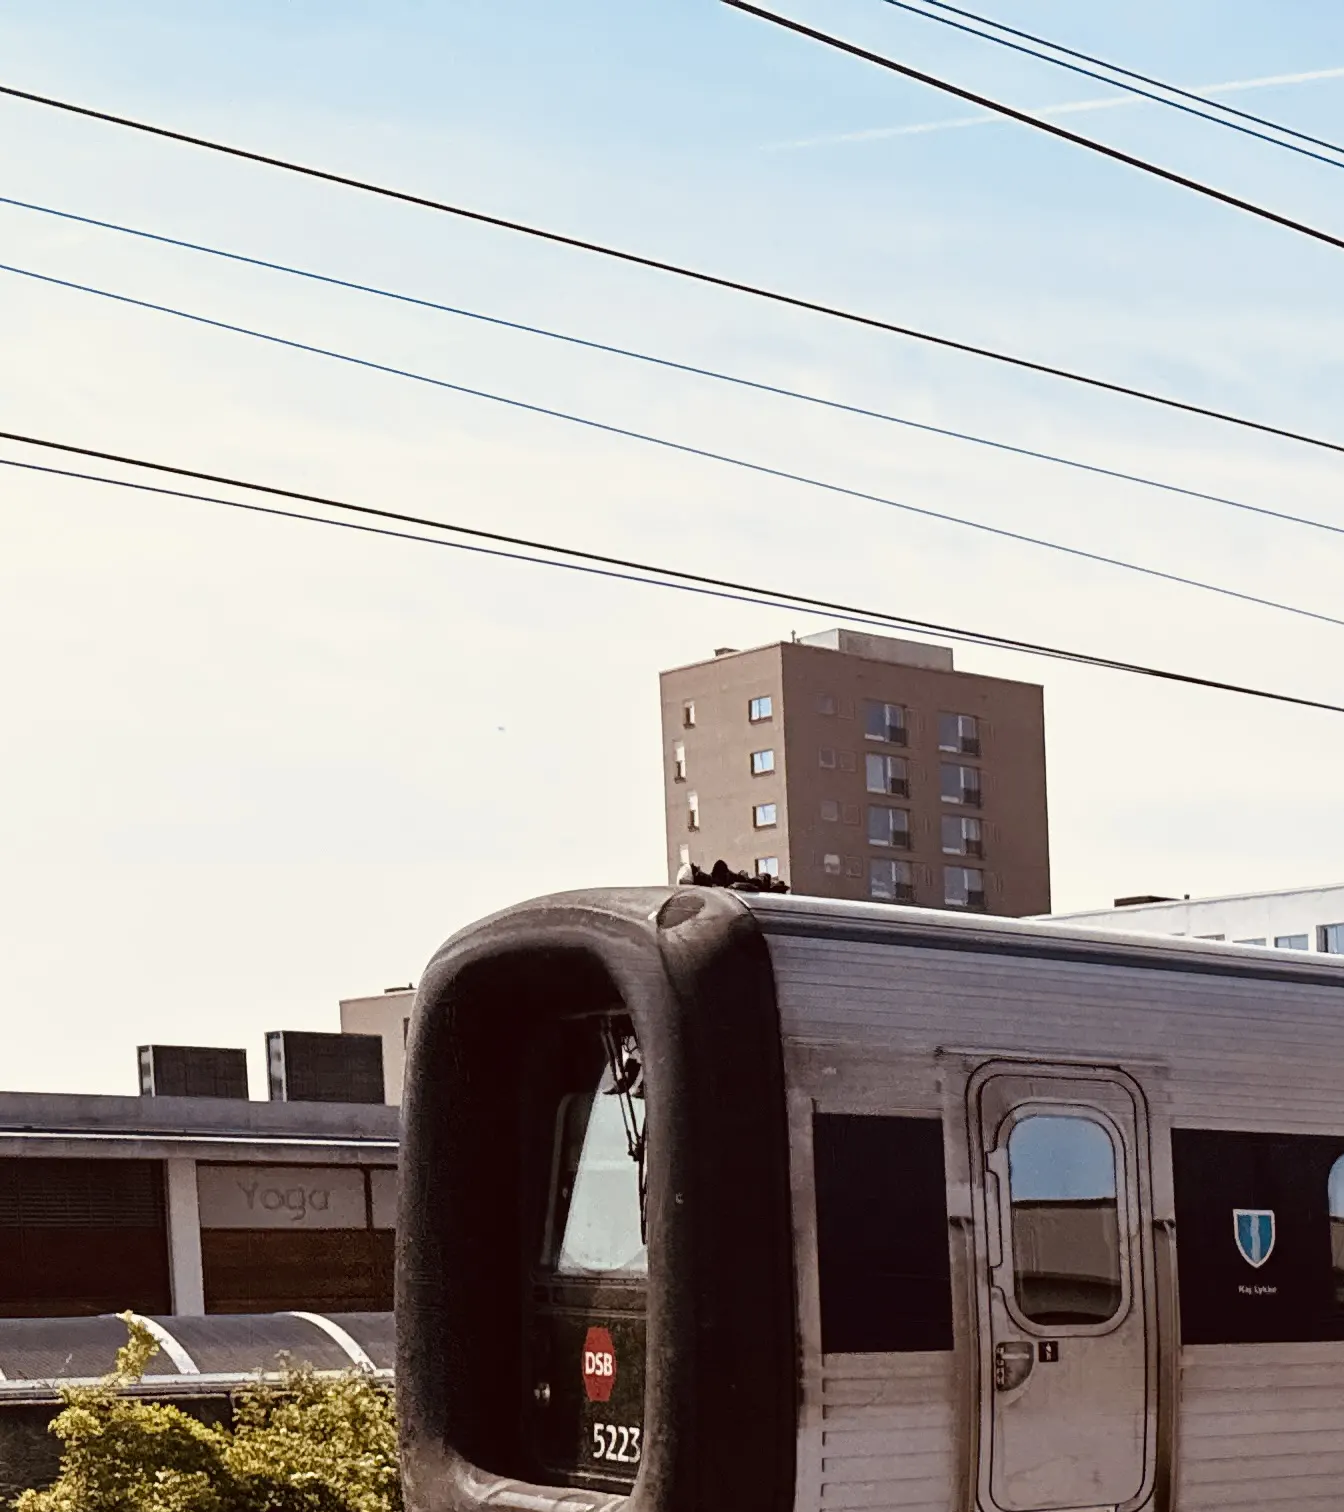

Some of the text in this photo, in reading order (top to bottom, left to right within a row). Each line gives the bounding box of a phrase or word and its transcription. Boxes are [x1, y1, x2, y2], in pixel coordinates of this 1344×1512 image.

[236, 1180, 330, 1221] Yoga
[584, 1351, 613, 1377] DSB
[592, 1422, 641, 1463] 5223
